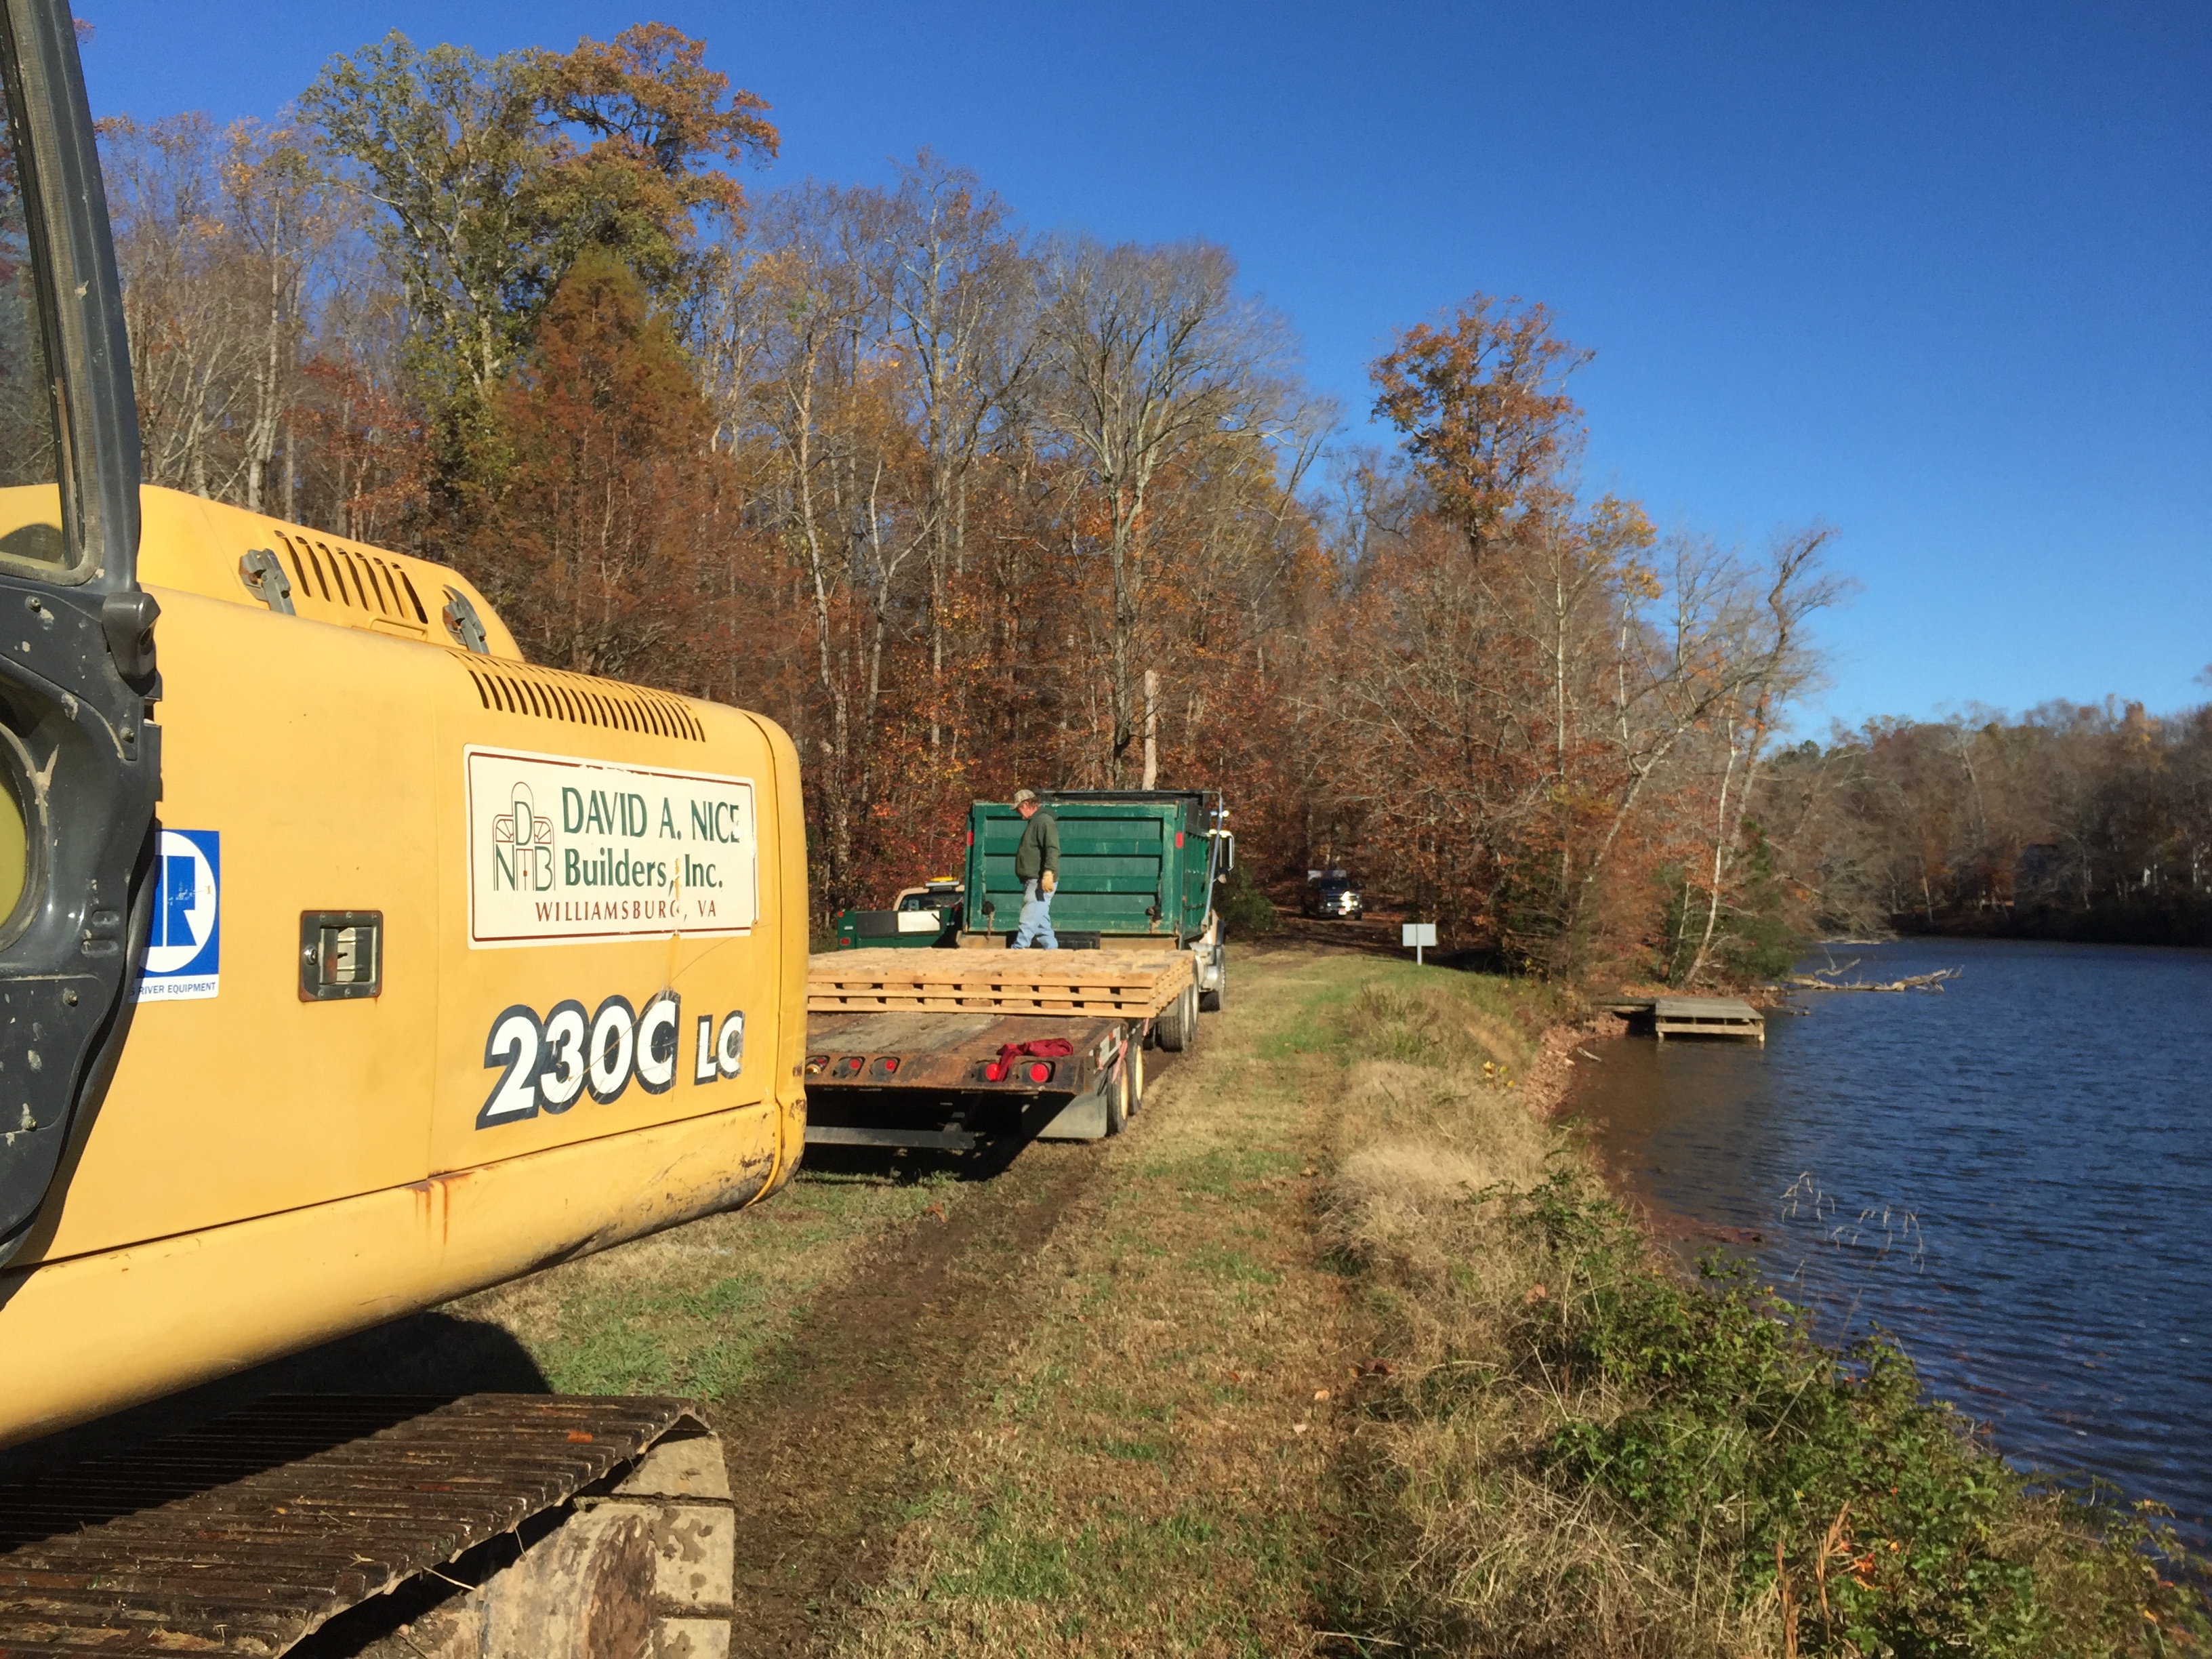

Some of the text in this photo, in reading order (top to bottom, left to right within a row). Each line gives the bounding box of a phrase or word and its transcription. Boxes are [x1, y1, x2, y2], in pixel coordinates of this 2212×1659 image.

[562, 786, 740, 844] DAVID A. NICE
[565, 848, 724, 897] Builders, Inc.
[697, 899, 716, 918] VA
[140, 985, 165, 995] RIVER
[167, 981, 216, 995] EQUIPMENT
[475, 987, 745, 1130] 230C LC
